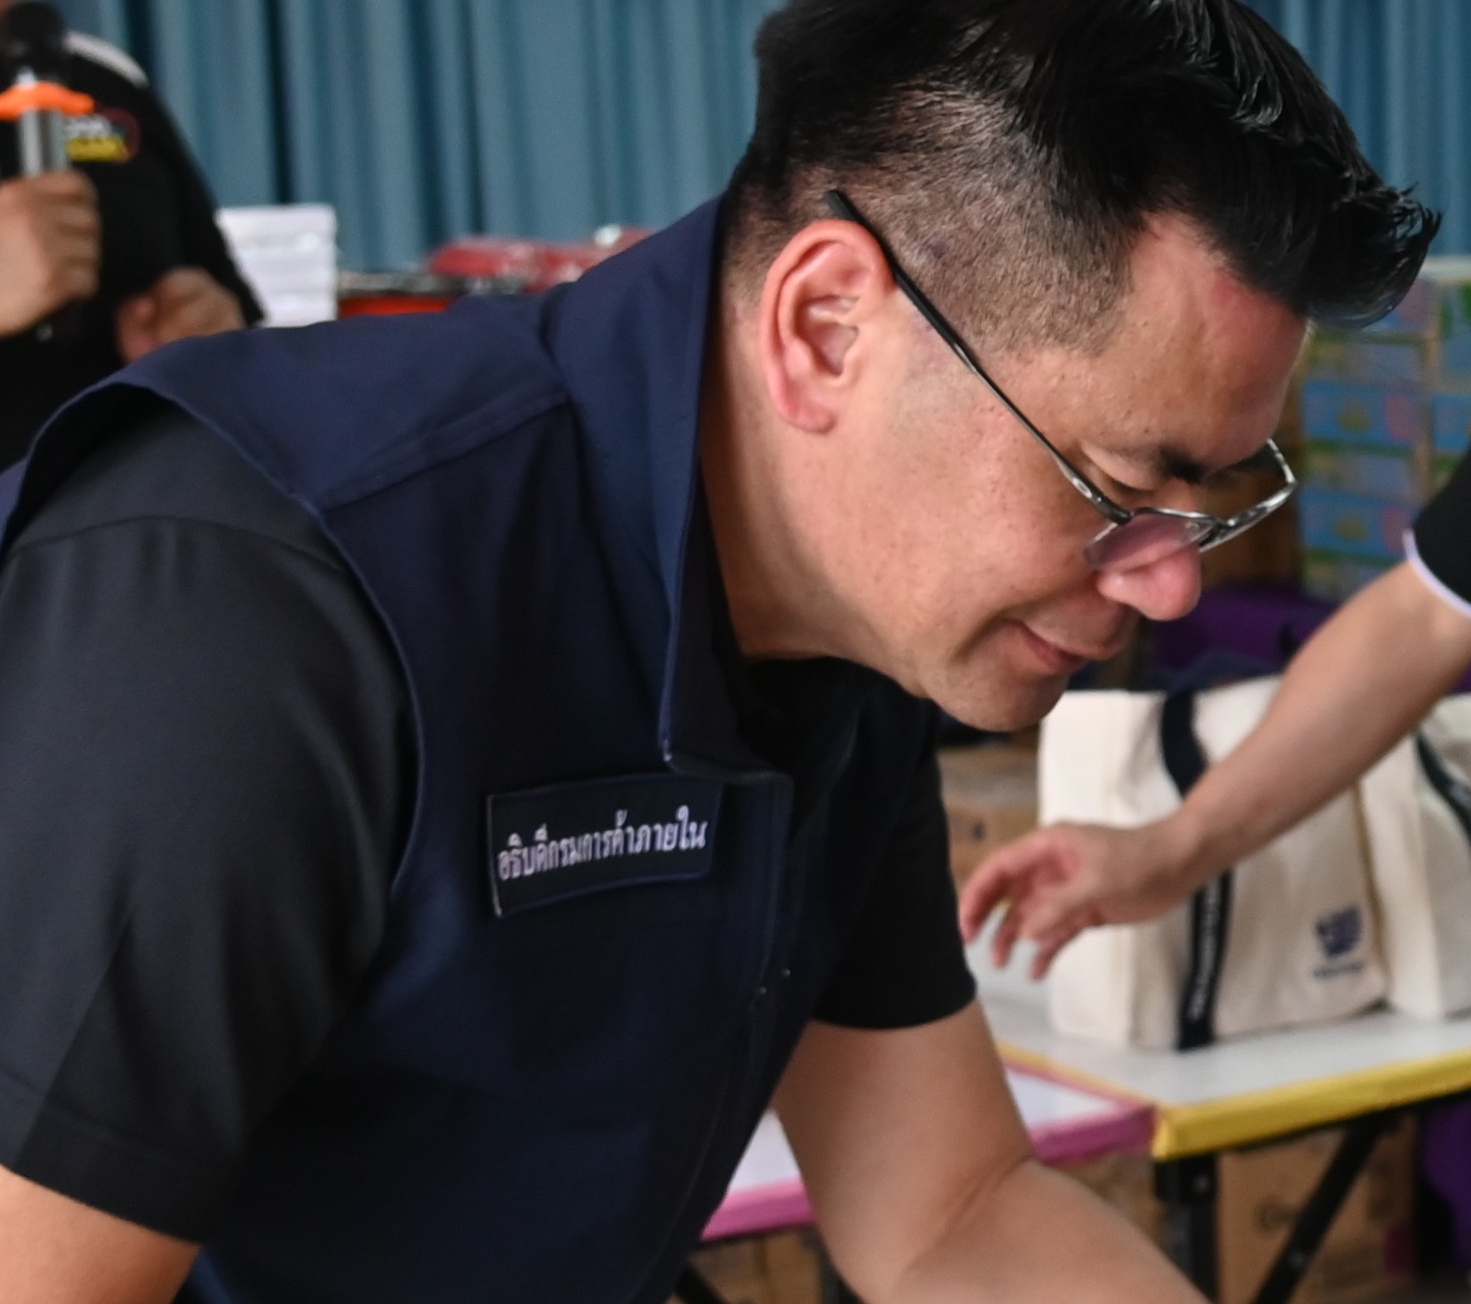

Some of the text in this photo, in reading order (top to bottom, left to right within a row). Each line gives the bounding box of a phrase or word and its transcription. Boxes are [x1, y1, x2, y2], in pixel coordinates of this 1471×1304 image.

[496, 805, 708, 881] อธิบดีกรมการค้าภายใน
